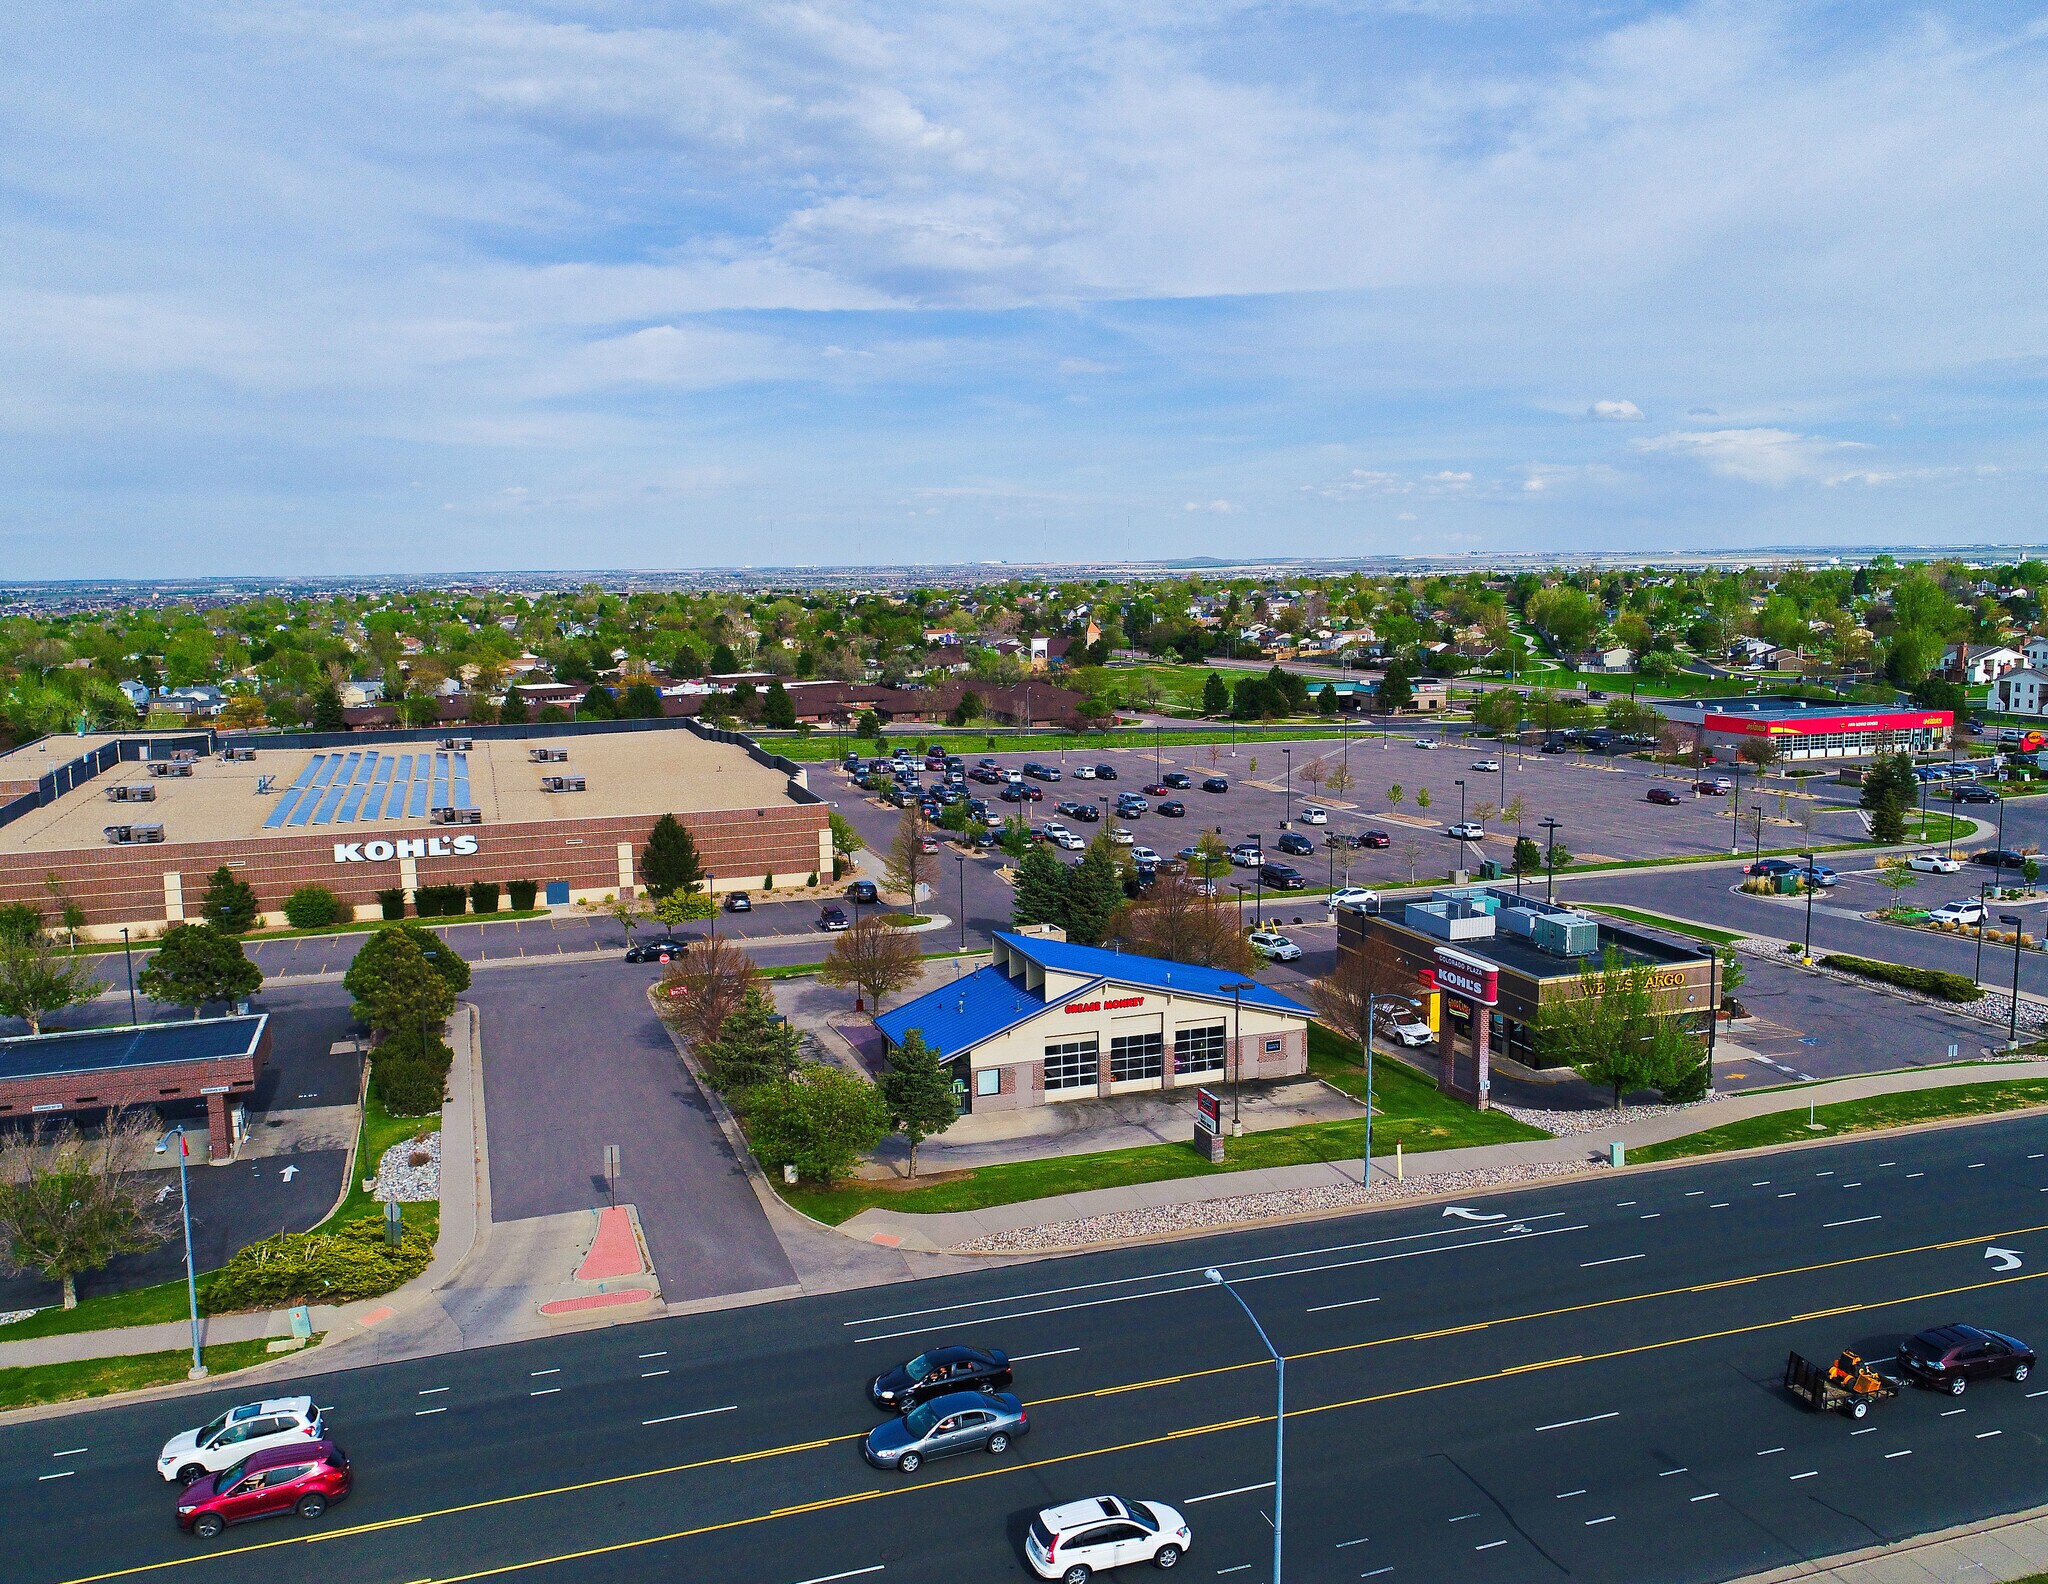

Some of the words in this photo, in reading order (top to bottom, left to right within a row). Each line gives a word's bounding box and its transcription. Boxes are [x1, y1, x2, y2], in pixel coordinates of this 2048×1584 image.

[333, 834, 479, 863] KOHL'S
[1439, 954, 1465, 970] COLORADO
[1466, 963, 1483, 976] PLAZA
[1438, 968, 1482, 994] KOHL'S
[1581, 979, 1633, 996] WELS
[1644, 973, 1685, 989] ARGO
[1065, 1002, 1101, 1014] GREASE
[1104, 997, 1144, 1010] MONKEY
